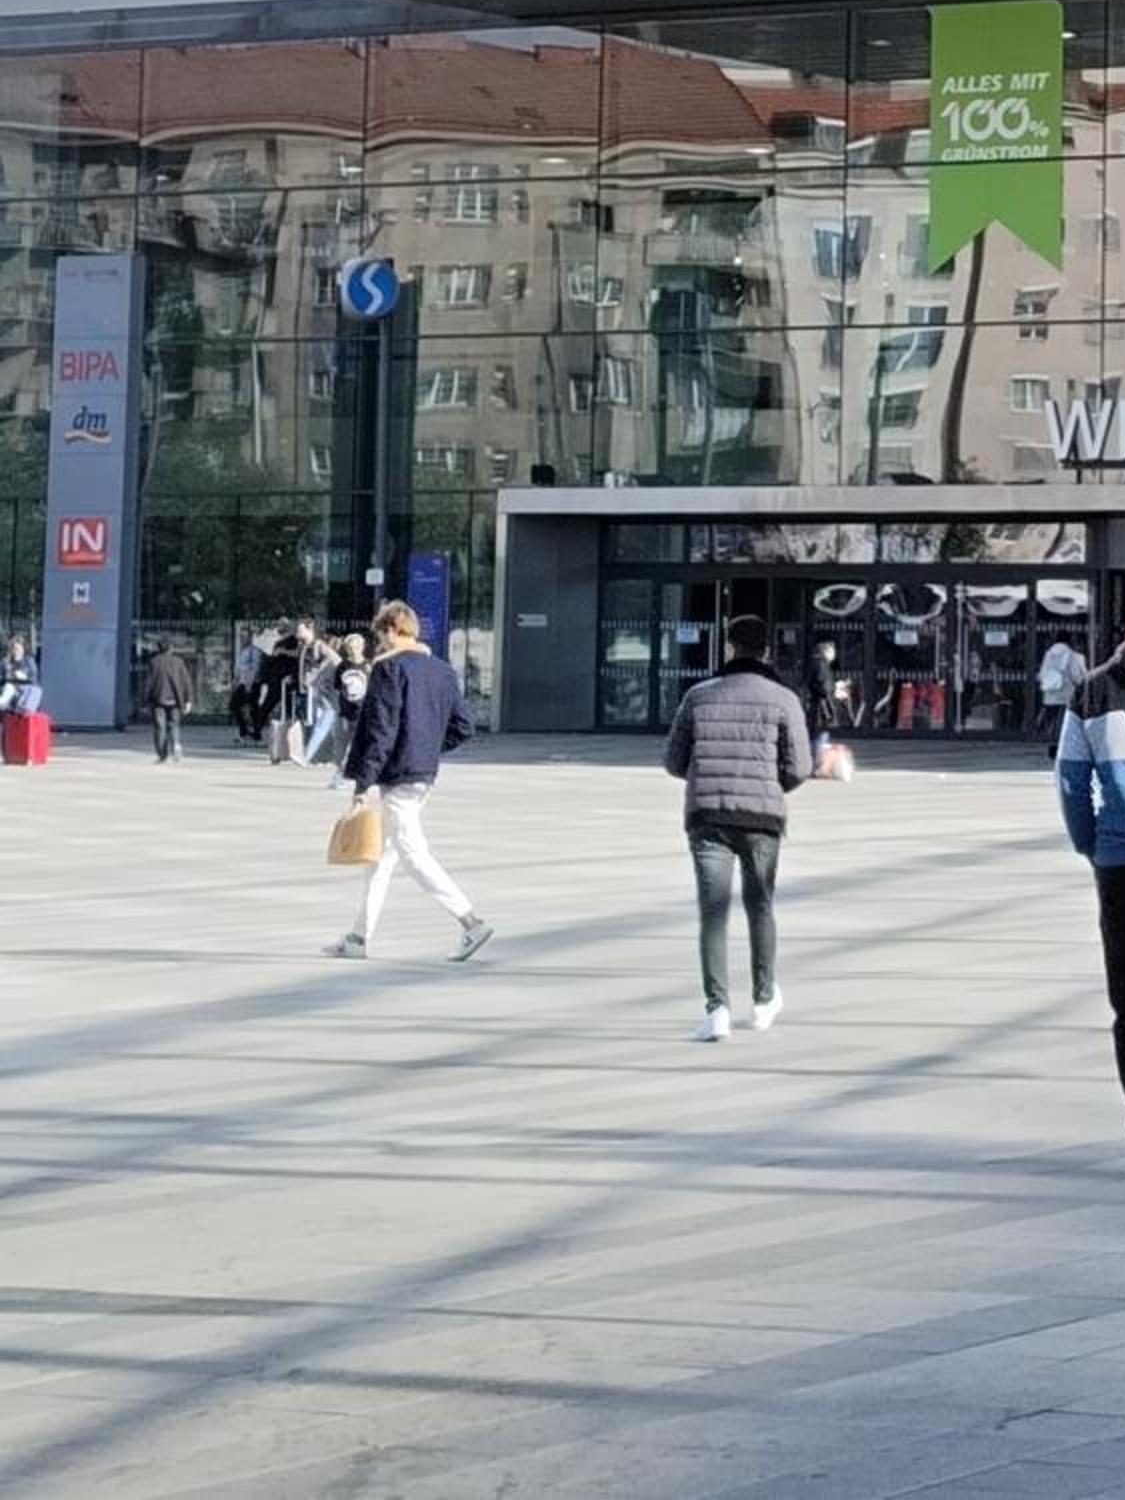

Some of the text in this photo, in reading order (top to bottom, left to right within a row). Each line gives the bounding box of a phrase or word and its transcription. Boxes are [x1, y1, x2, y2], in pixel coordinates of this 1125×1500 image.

[941, 72, 1050, 95] ALLES MIT
[941, 144, 1049, 162] GRÜNSTROM
[60, 352, 119, 381] BIPA
[73, 405, 107, 430] dm
[62, 522, 105, 553] IN
